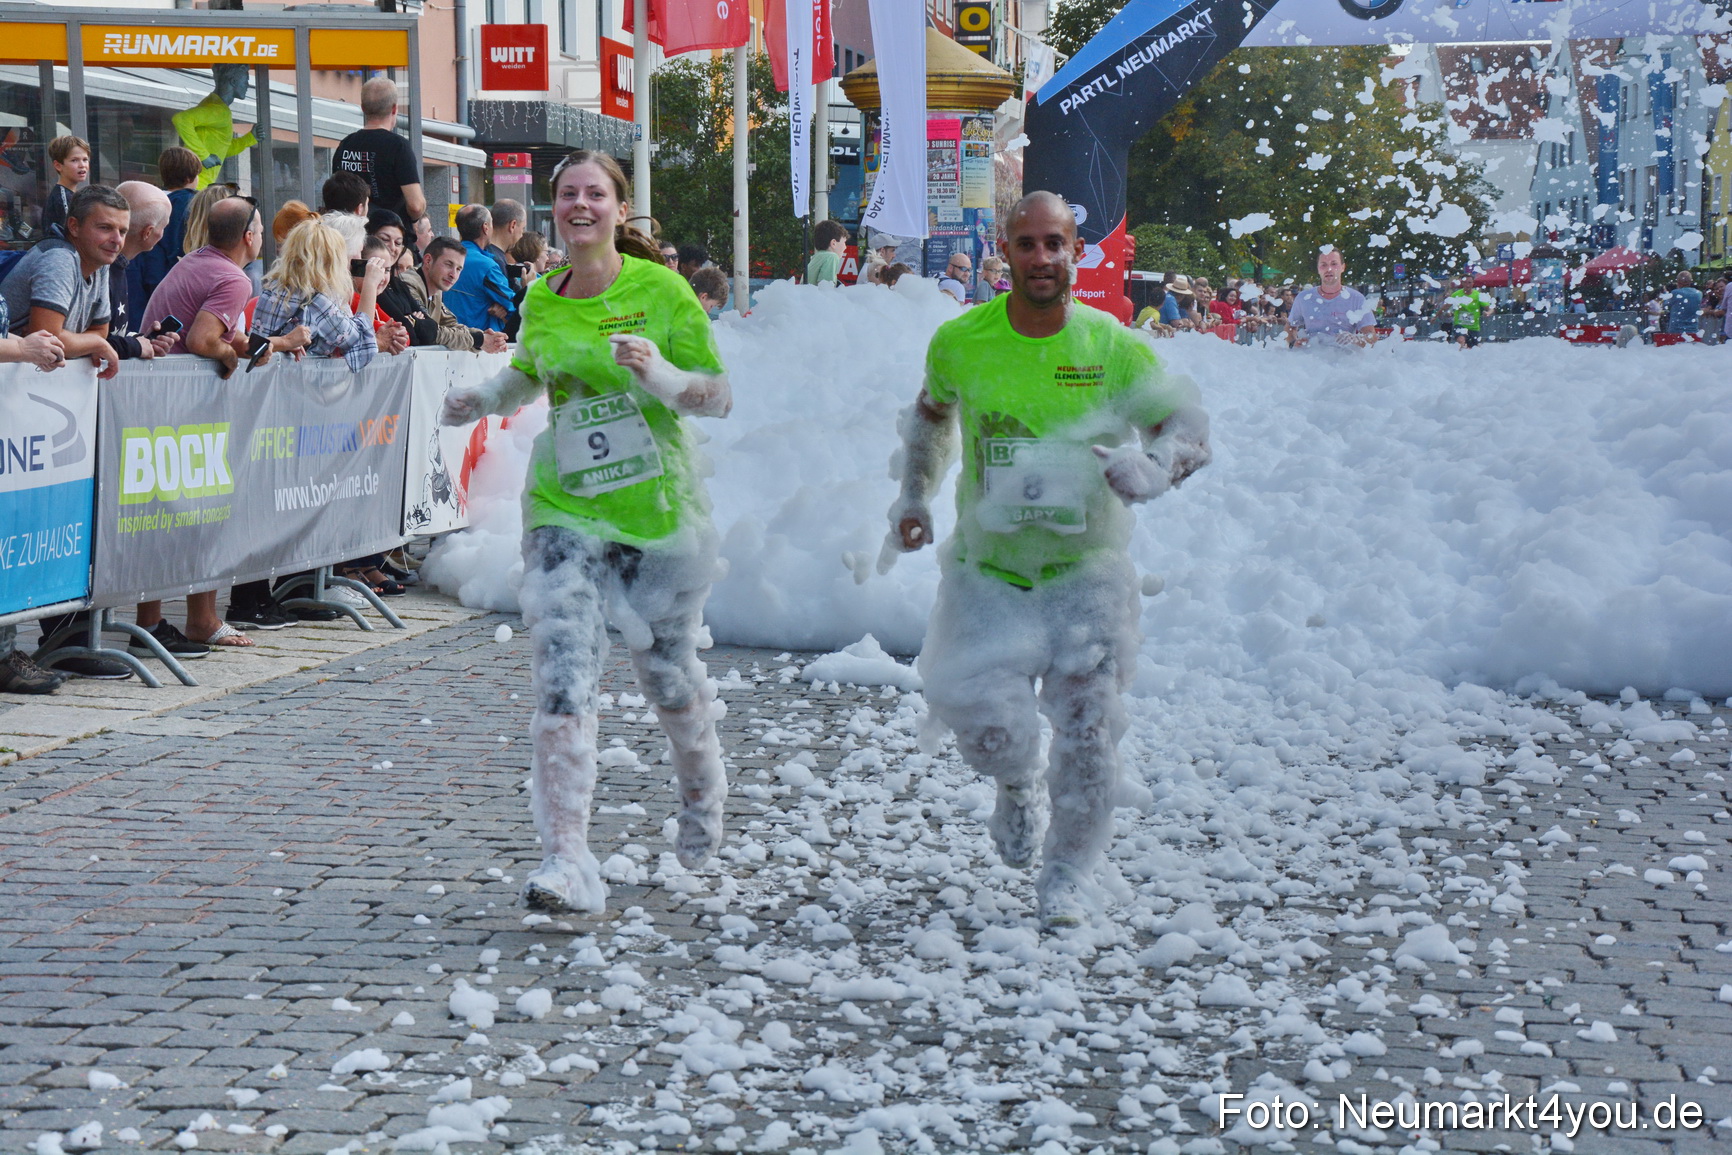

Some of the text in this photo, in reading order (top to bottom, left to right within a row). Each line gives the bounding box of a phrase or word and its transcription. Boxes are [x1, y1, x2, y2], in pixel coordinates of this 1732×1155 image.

[103, 33, 279, 57] RUNMARKT.DE
[490, 46, 536, 63] WITT
[1059, 7, 1214, 116] PARTL NEUMARKT
[931, 140, 956, 148] SUNRISE
[250, 426, 295, 462] OFFICE
[297, 420, 358, 457] INDUSTRY
[588, 431, 610, 460] 9
[122, 430, 232, 497] BOCK
[582, 463, 634, 484] ANIKA
[117, 503, 232, 537] inspired by smart concepts
[18, 522, 83, 568] ZUHAUSE
